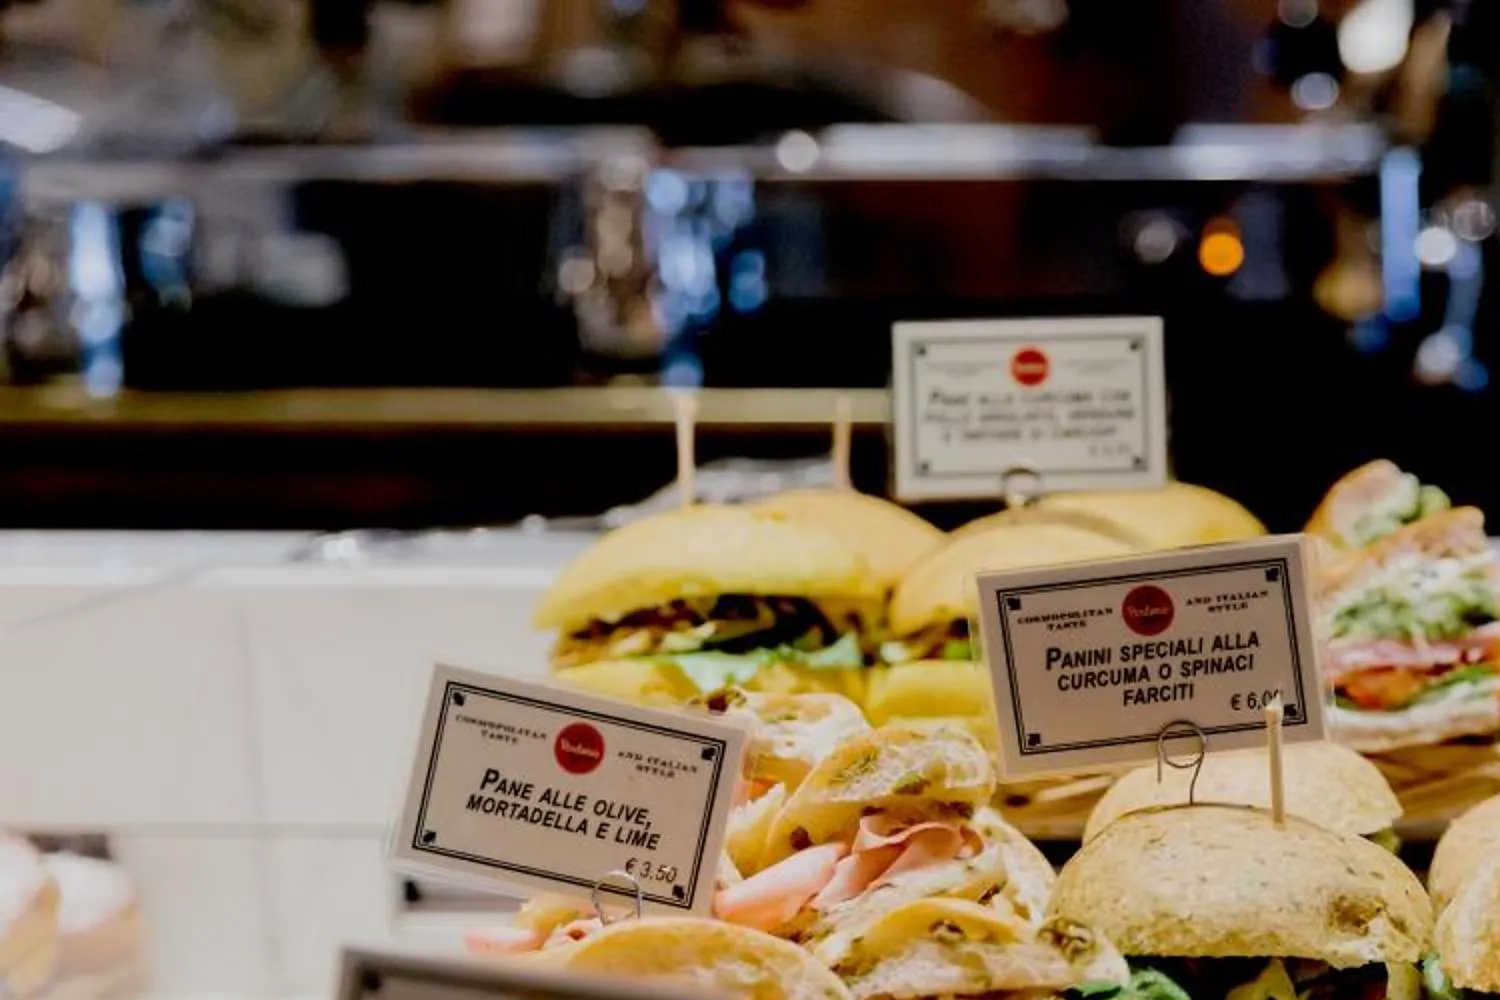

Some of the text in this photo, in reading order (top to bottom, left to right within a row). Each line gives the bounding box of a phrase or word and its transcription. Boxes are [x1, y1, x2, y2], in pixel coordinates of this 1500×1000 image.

[1045, 631, 1260, 670] PANINI SPECIALI ALLA
[1057, 654, 1254, 691] CURCUMA O SPINACI
[1123, 683, 1195, 706] FARCITI
[1230, 693, 1241, 711] €
[480, 768, 653, 831] PANE ALLE OLIVE,
[466, 795, 661, 851] MORTADELLA E LIME
[625, 857, 638, 874] €
